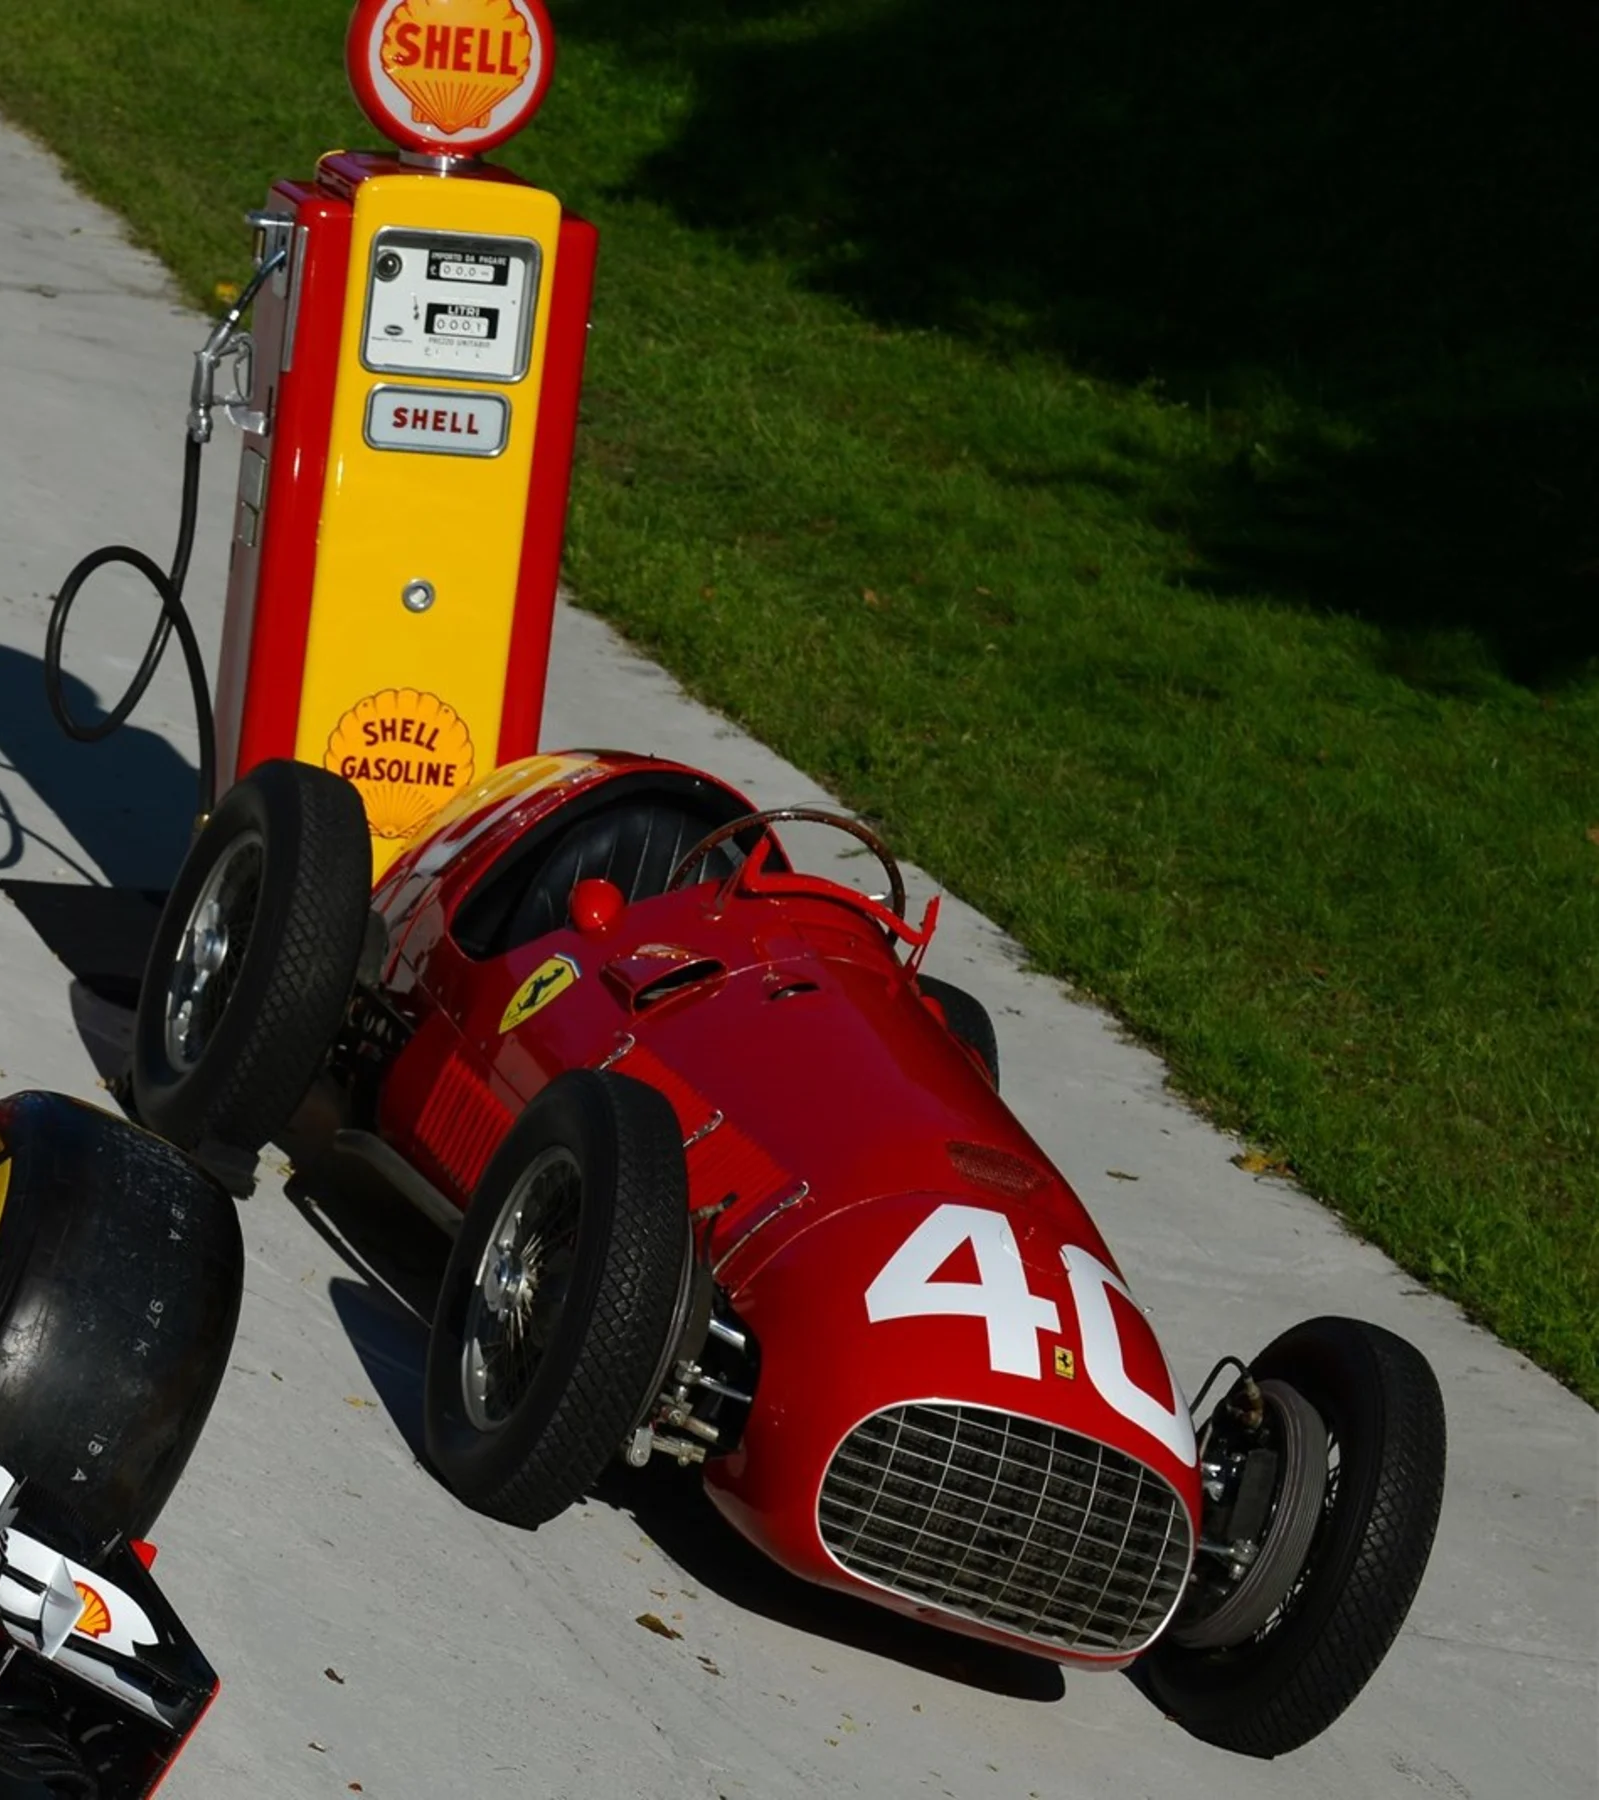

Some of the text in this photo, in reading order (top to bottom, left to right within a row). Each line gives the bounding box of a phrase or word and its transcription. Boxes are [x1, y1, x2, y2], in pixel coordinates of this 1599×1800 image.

[392, 22, 518, 76] SHELL
[447, 305, 480, 317] LITRI
[392, 406, 479, 435] SHELL
[362, 718, 439, 752] SHELL
[341, 755, 457, 787] GASOLINE
[864, 1203, 1197, 1469] 40
